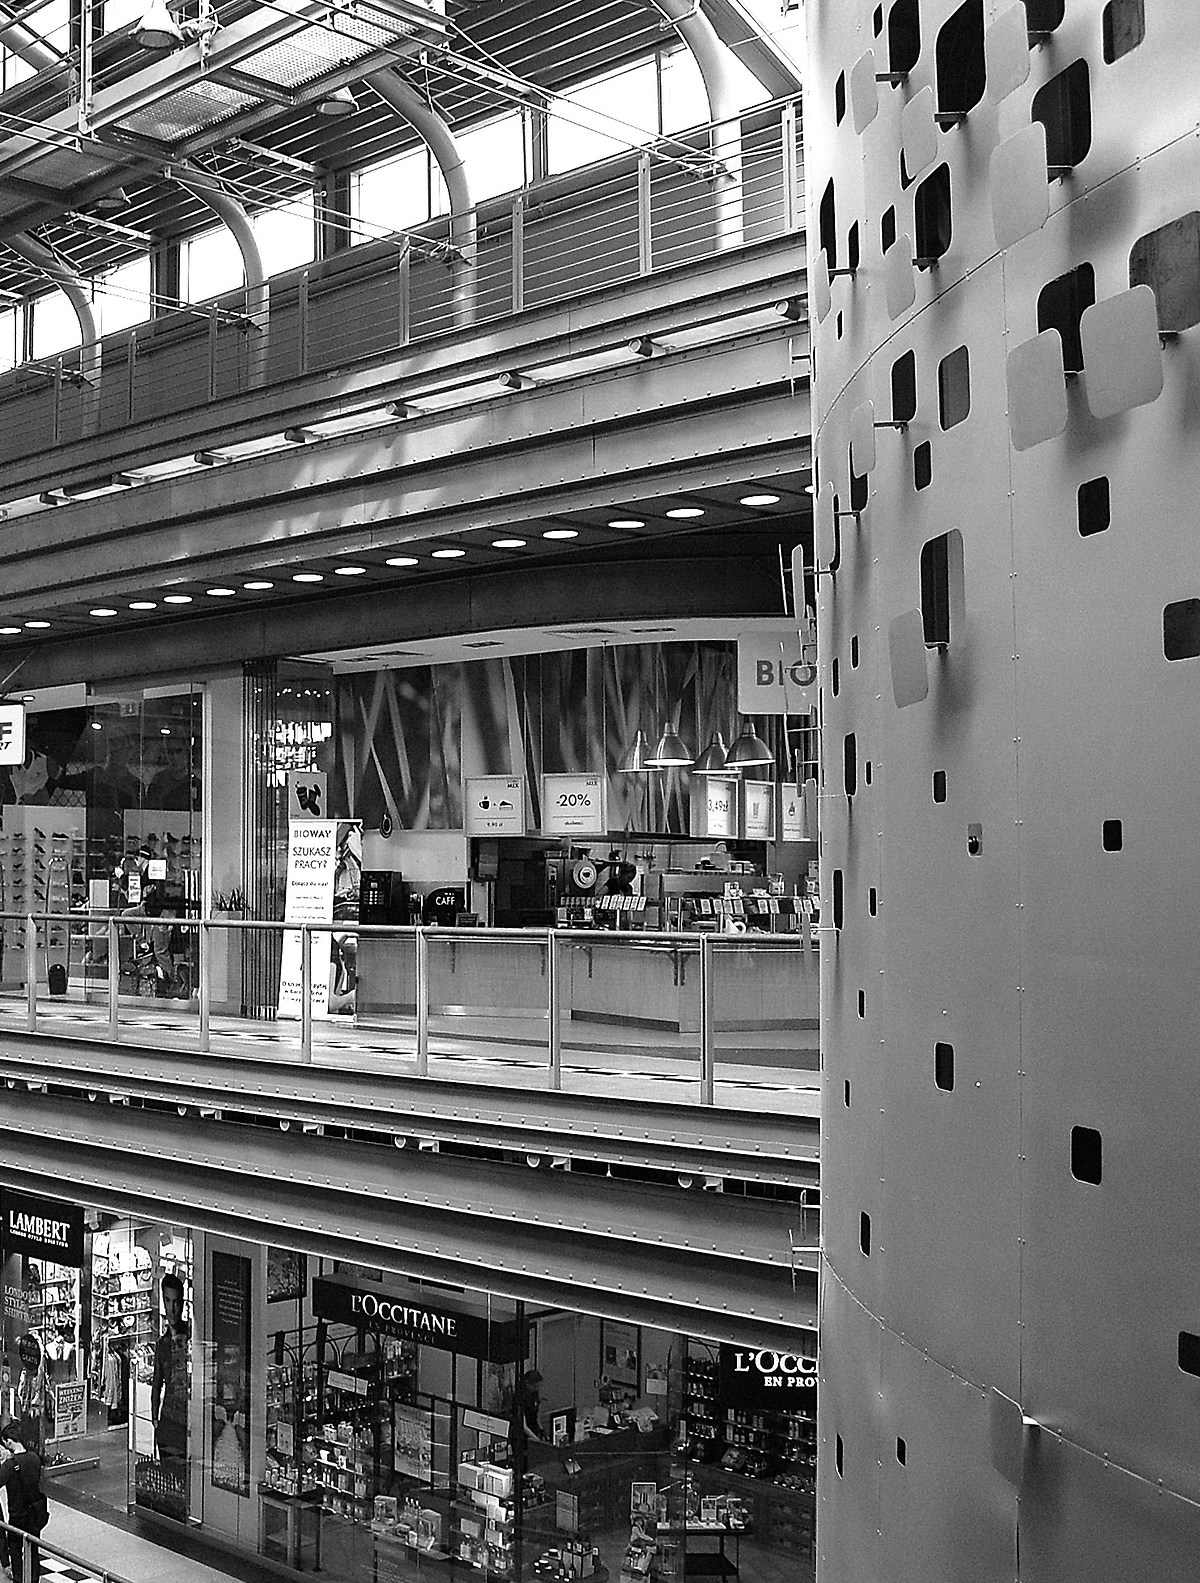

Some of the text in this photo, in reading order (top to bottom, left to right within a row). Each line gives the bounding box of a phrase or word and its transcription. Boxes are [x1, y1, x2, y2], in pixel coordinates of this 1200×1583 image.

[555, 793, 591, 807] -20%
[293, 829, 332, 838] BIOWAY
[292, 846, 332, 856] SZUKASZ
[294, 859, 328, 869] PRACY?
[9, 1209, 71, 1242] LAMBERT
[351, 1294, 457, 1337] L'OCCITANE
[763, 1376, 783, 1387] EN
